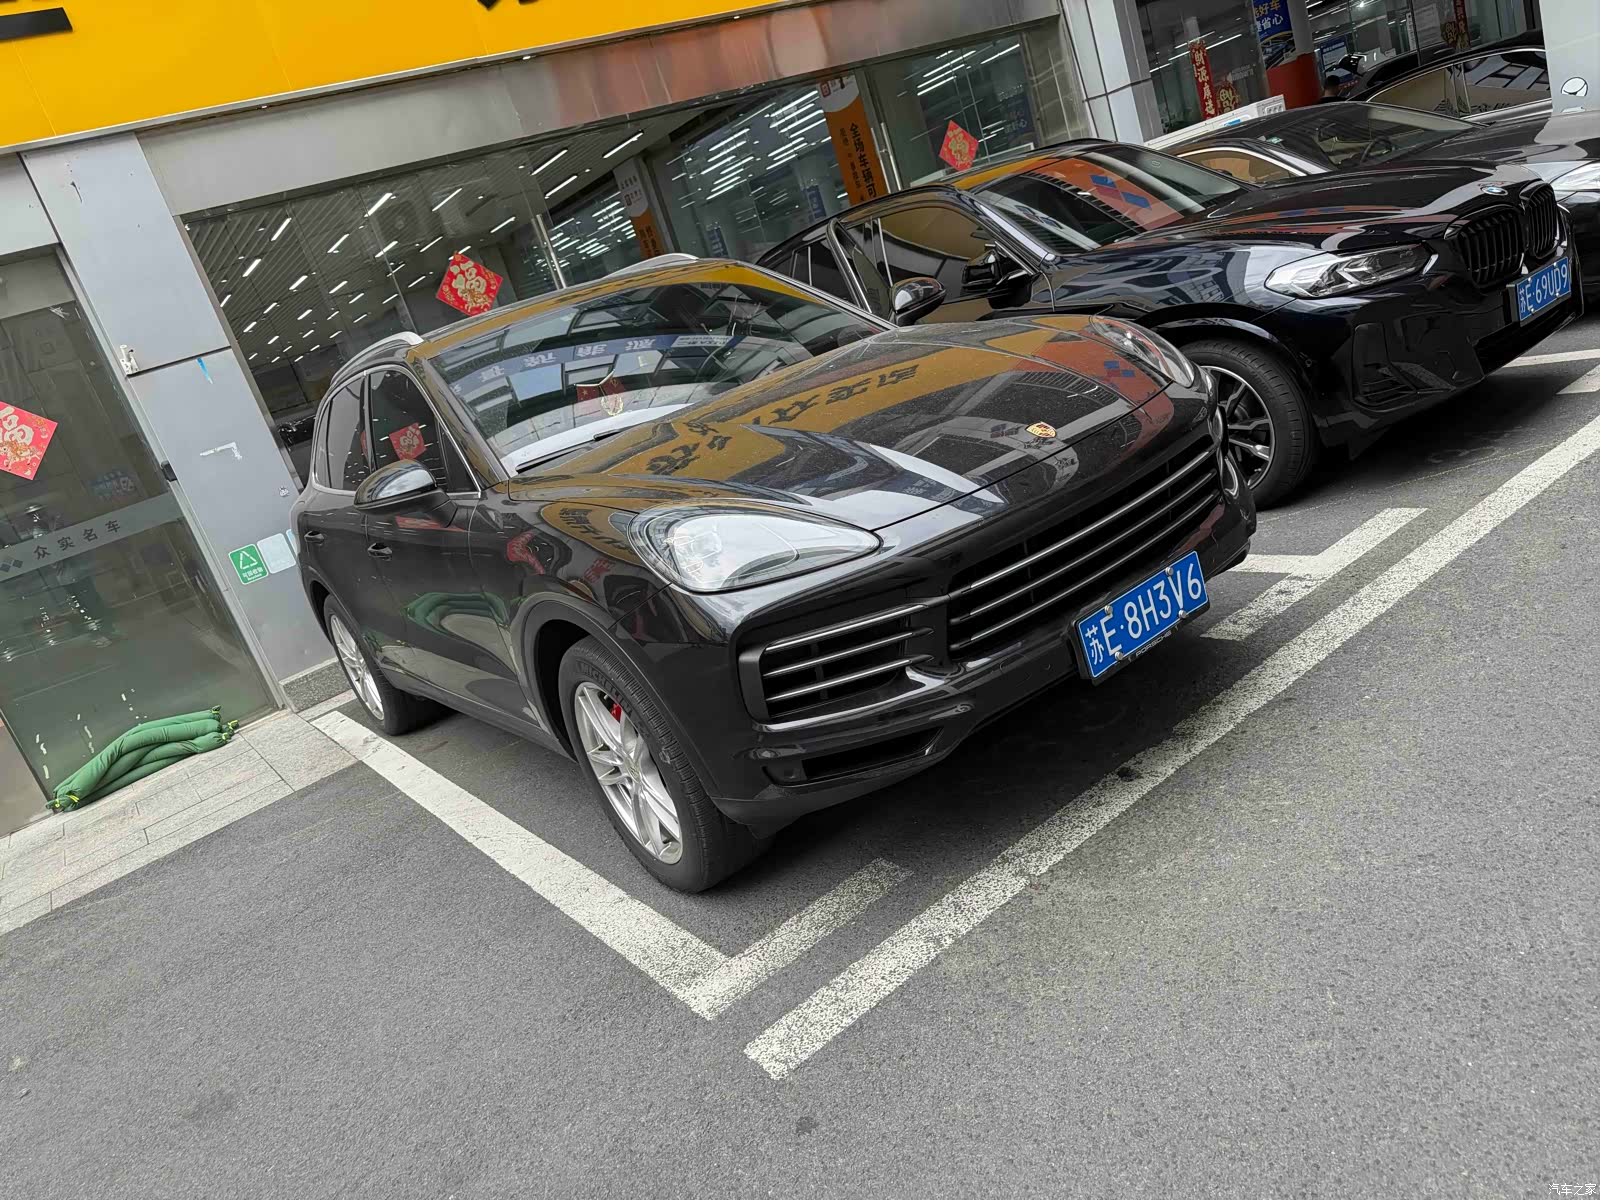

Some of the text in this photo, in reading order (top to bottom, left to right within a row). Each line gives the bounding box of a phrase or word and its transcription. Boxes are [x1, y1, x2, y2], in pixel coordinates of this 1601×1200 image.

[449, 260, 488, 300] 福
[33, 520, 121, 560] 众实名车
[1085, 563, 1201, 665] 苏E·8H3V6
[1135, 630, 1172, 657] PORSCHE
